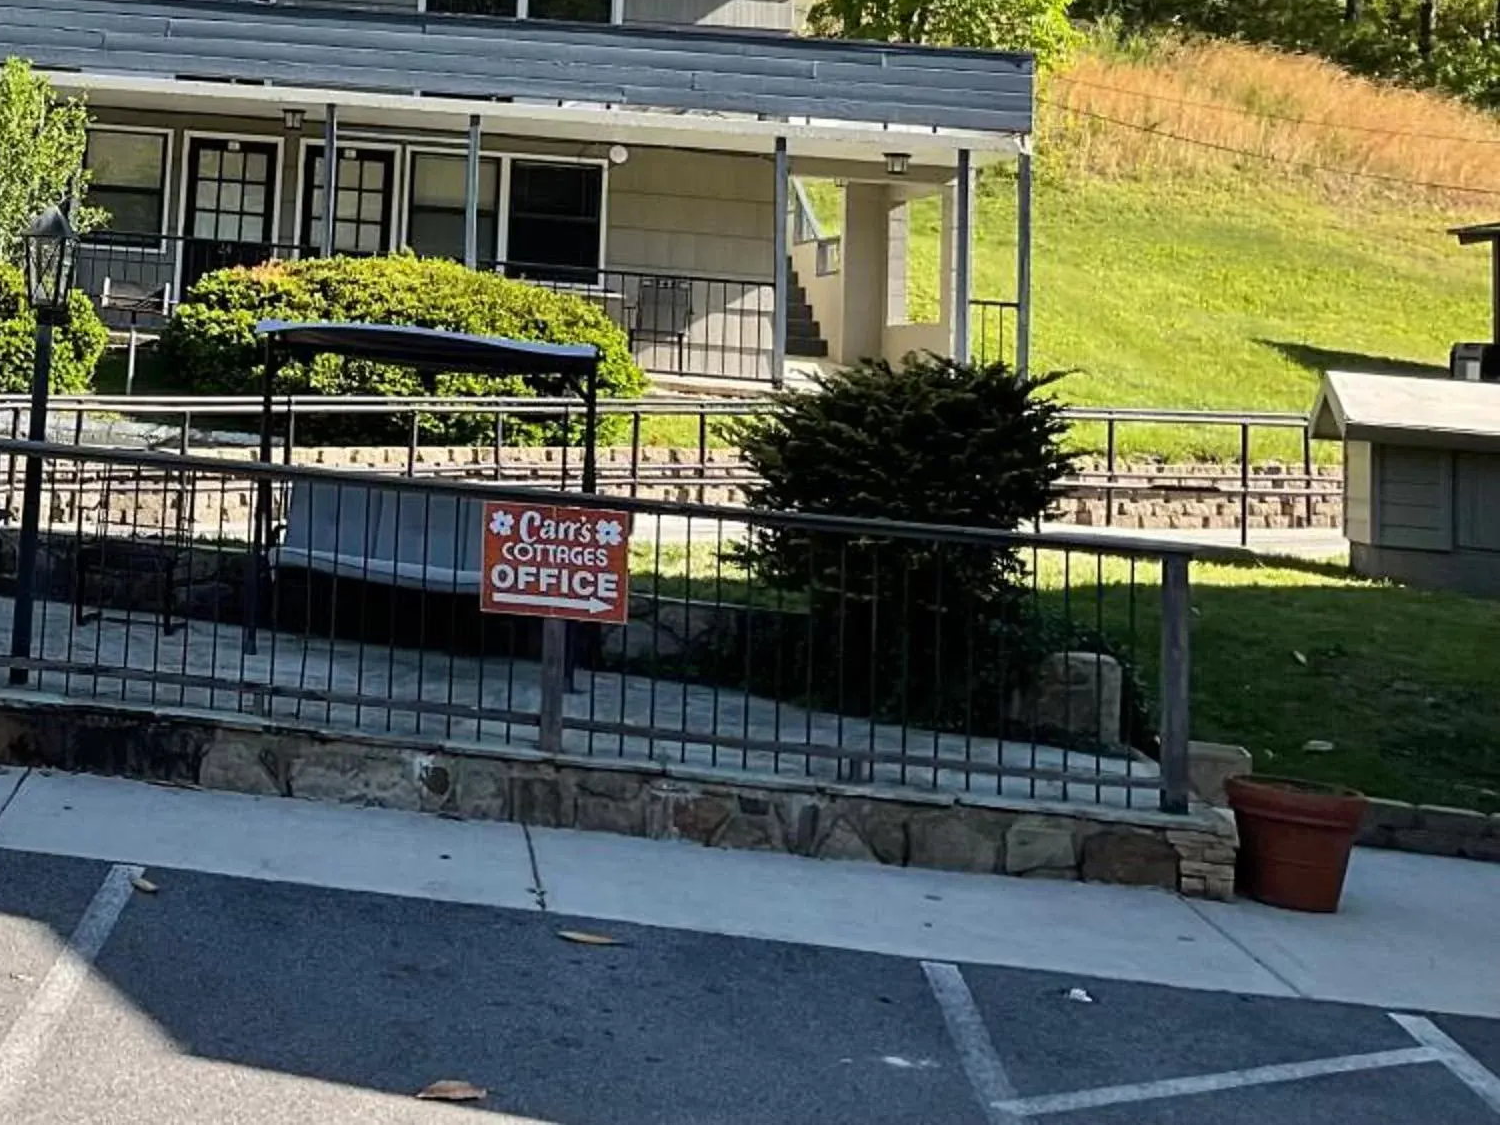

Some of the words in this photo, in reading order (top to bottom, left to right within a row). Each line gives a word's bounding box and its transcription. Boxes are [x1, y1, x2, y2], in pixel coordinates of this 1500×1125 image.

[519, 510, 592, 543] Carr's
[502, 542, 608, 567] COTTAGES
[491, 564, 618, 598] OFFICE
